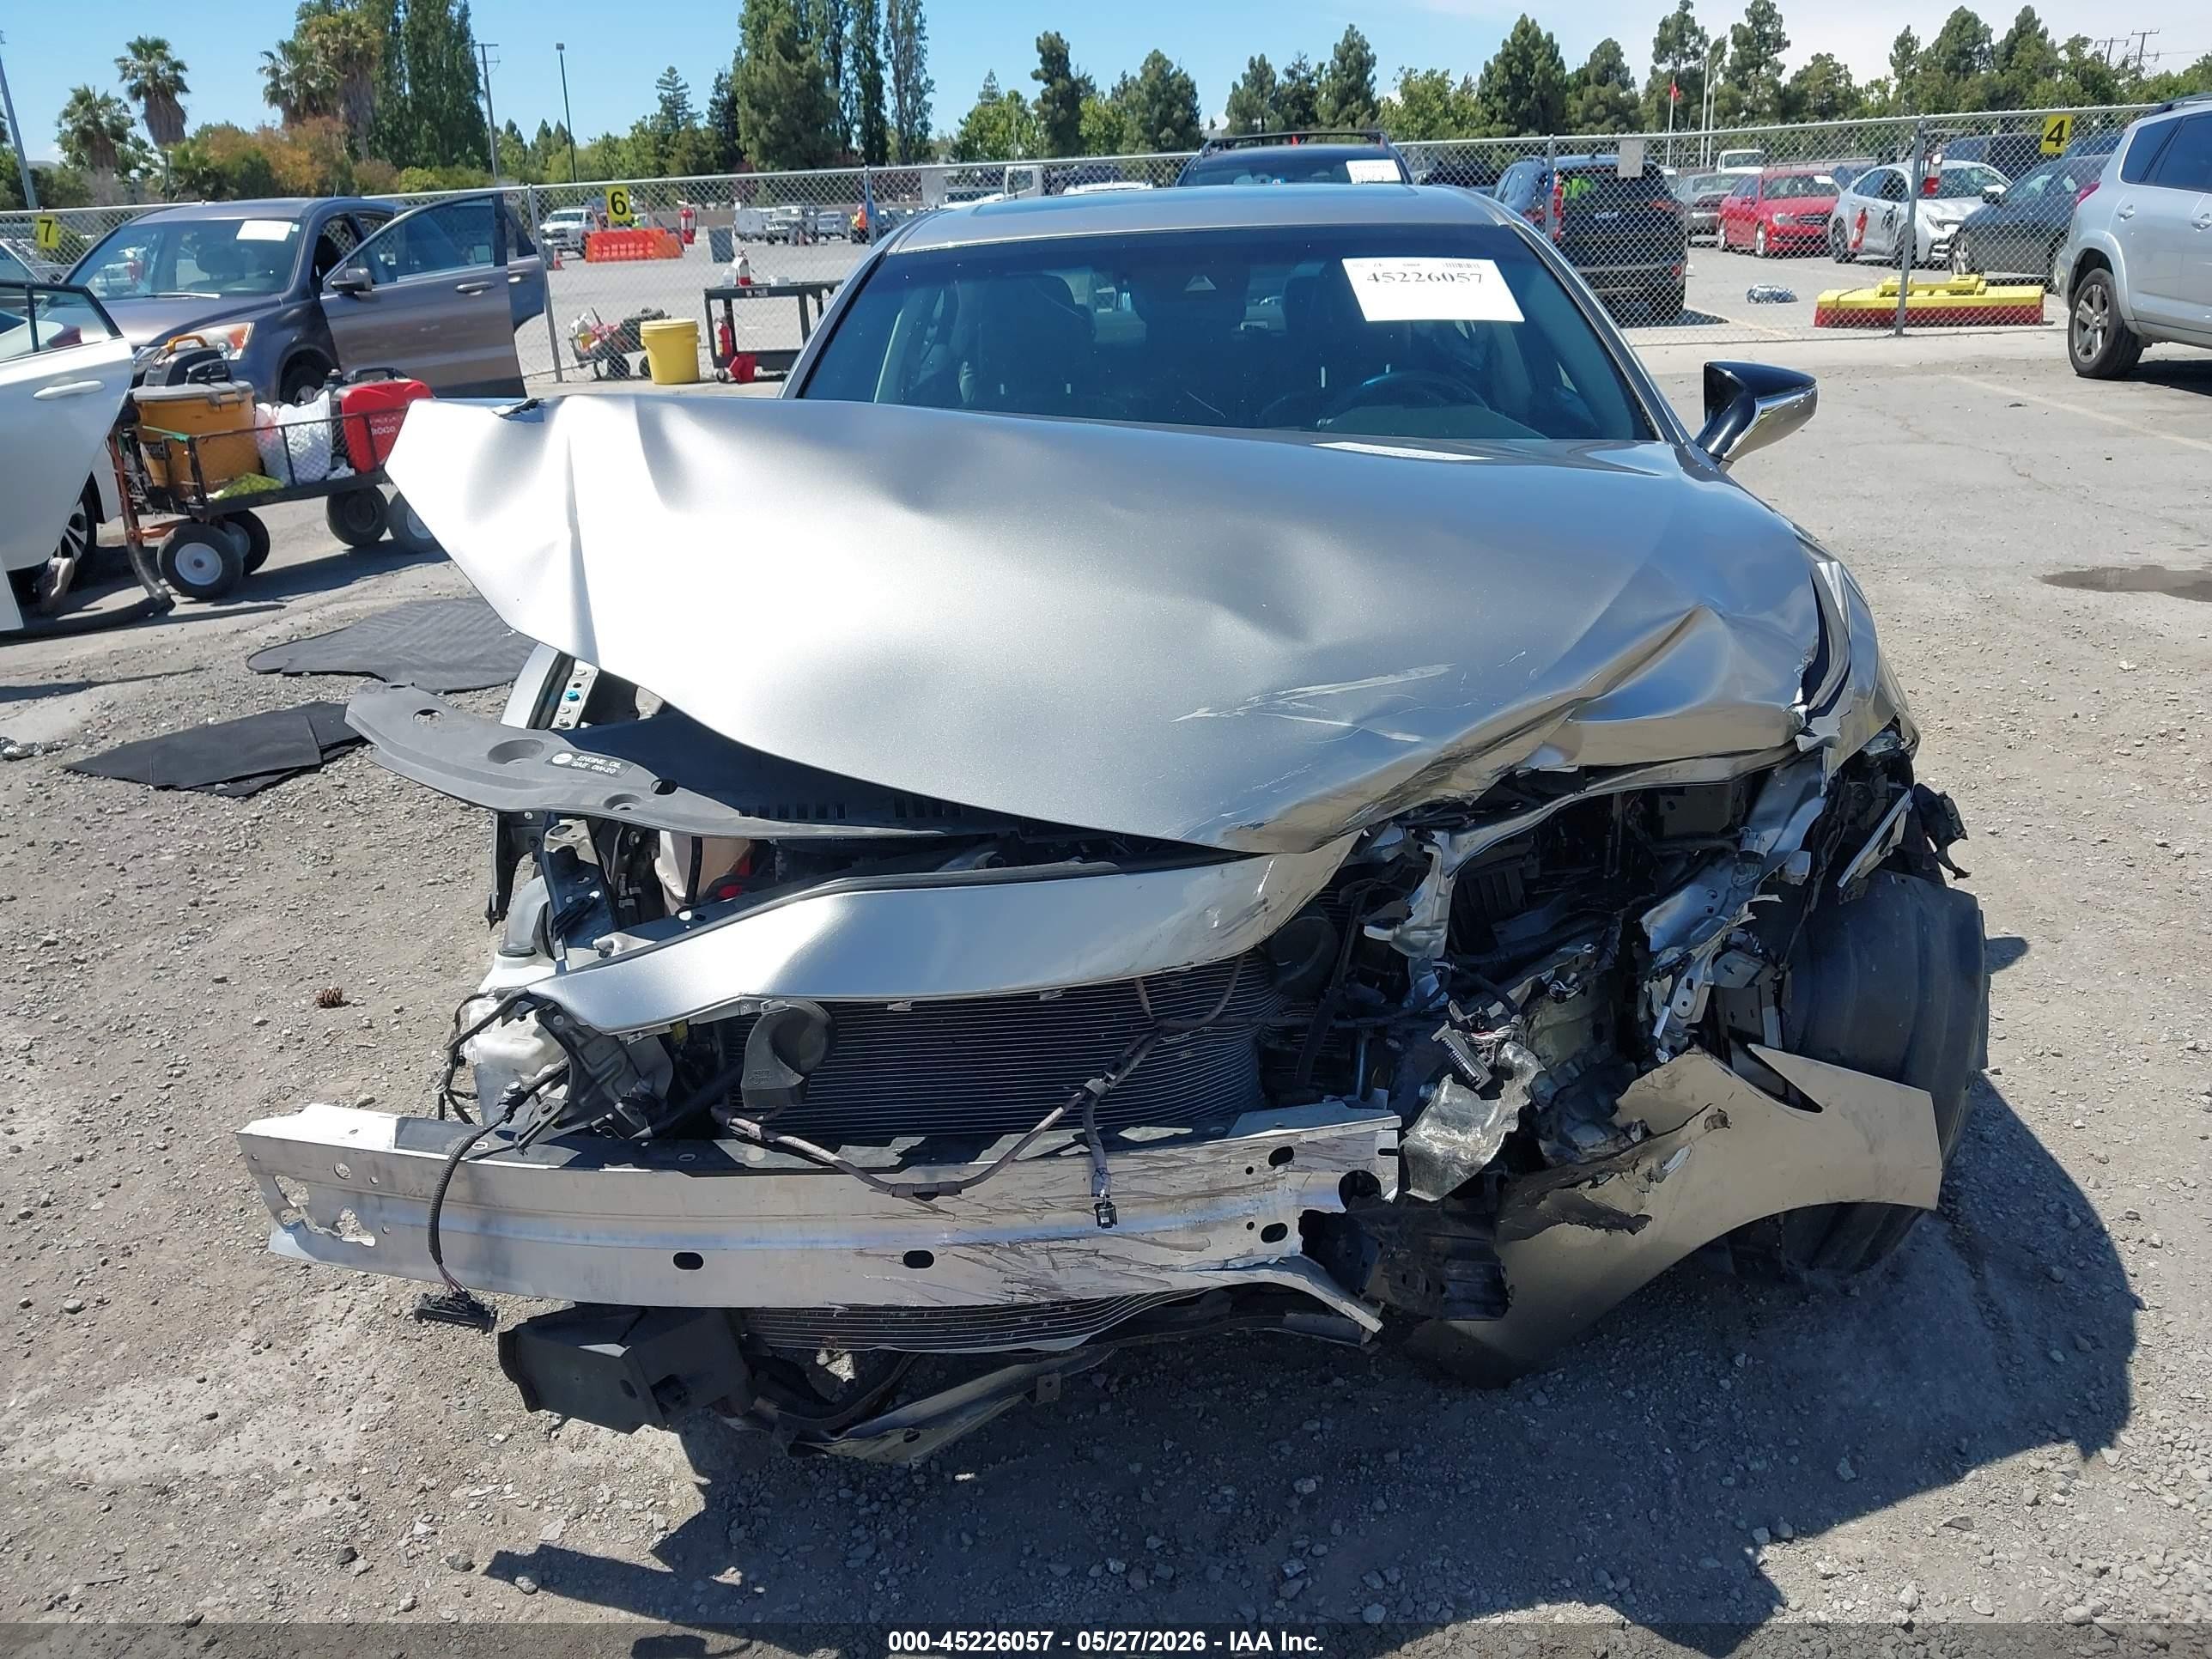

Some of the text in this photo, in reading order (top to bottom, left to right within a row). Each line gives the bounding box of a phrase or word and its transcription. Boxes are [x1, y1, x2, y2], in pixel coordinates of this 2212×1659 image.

[2045, 119, 2065, 147] 4
[611, 191, 626, 216] 6
[40, 219, 52, 242] 7
[1366, 271, 1483, 283] 45226057
[576, 755, 606, 765] ENGINE
